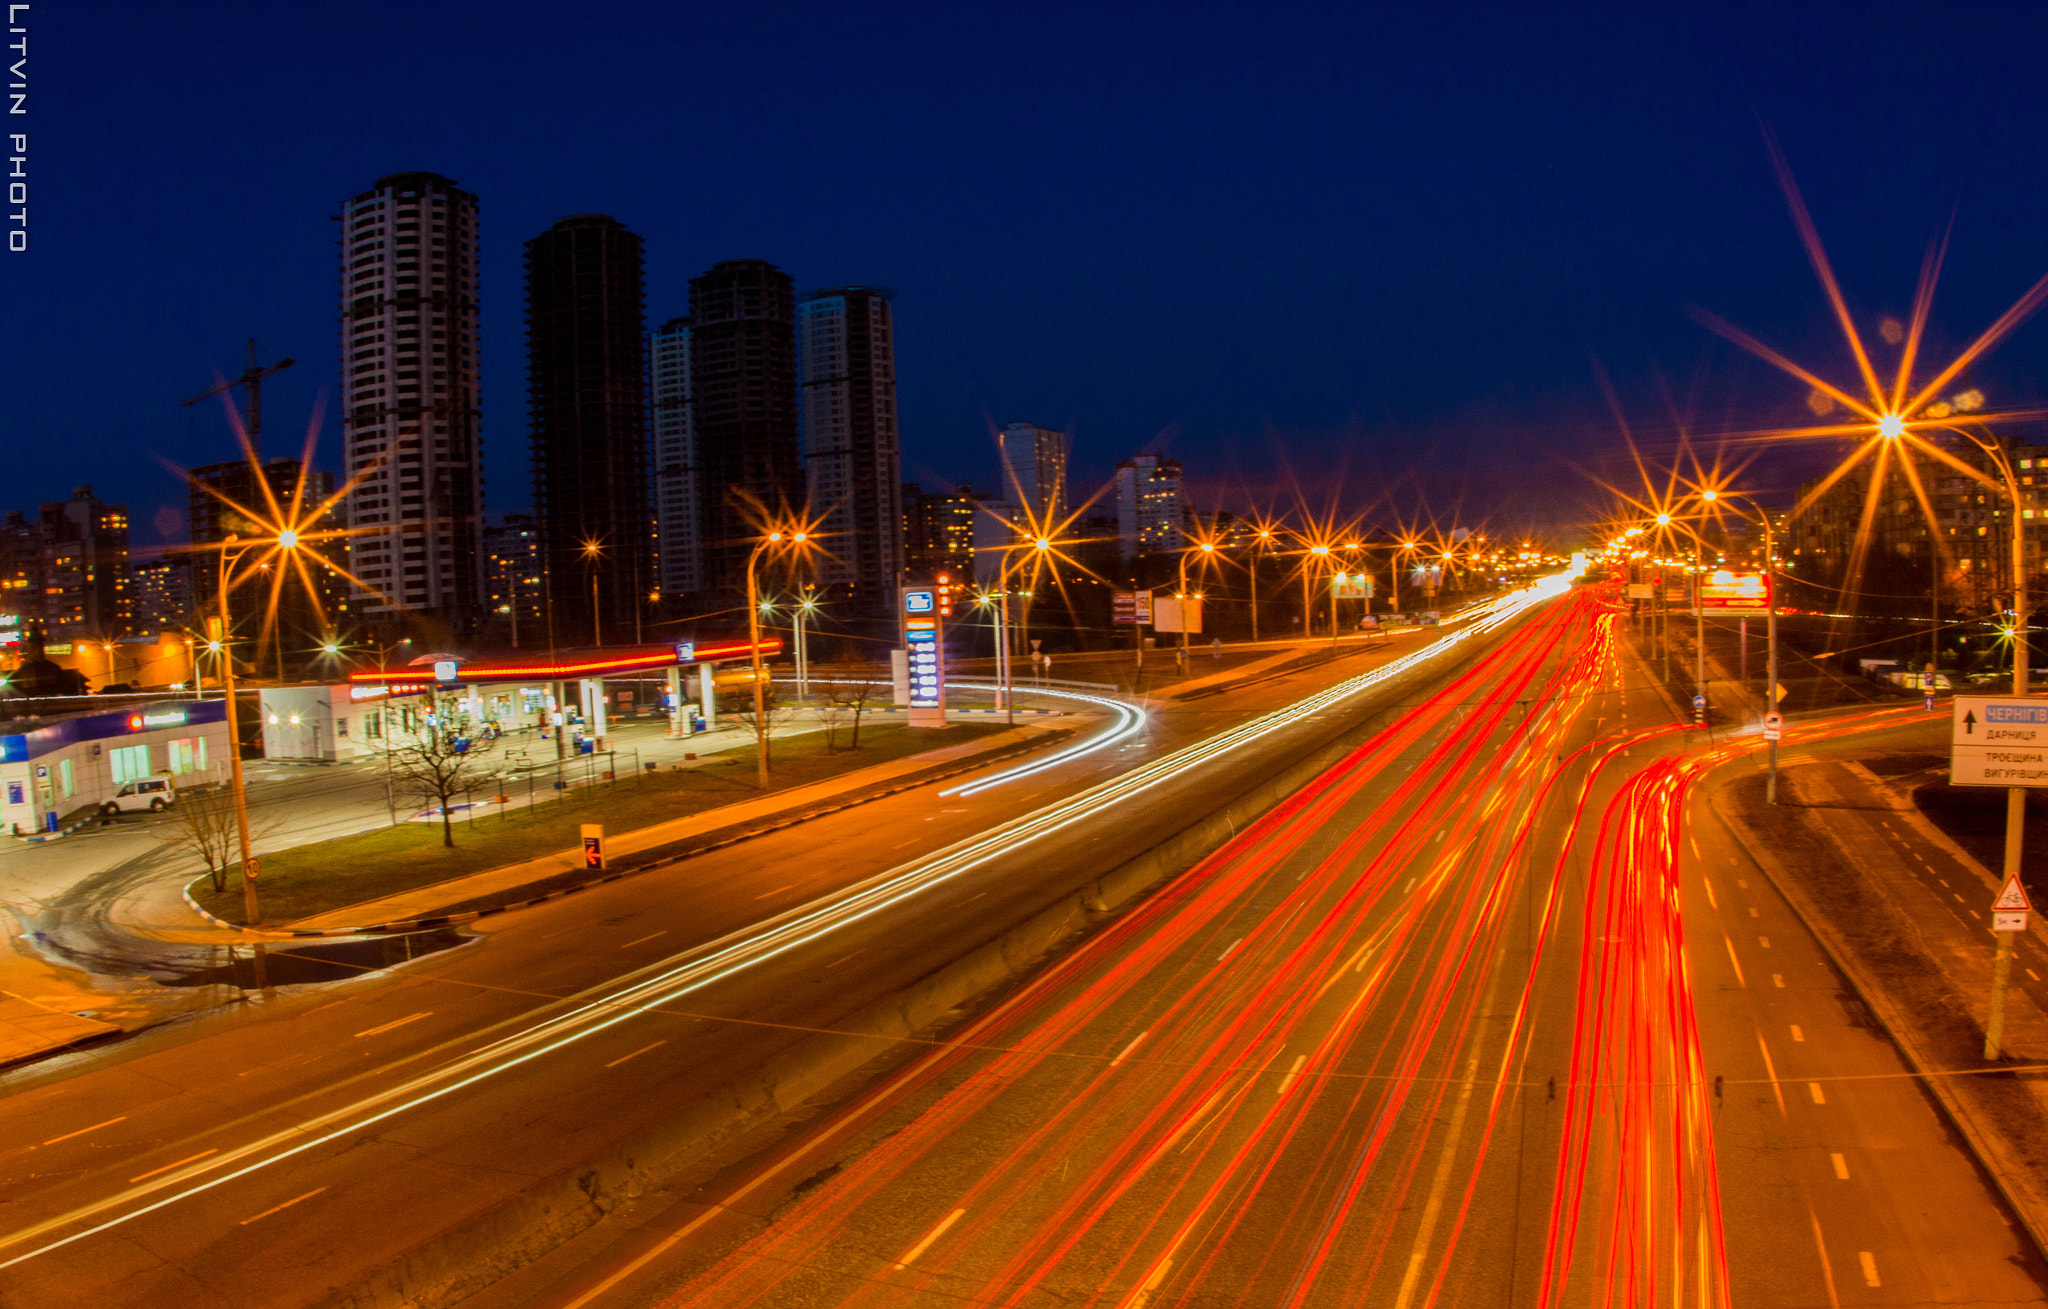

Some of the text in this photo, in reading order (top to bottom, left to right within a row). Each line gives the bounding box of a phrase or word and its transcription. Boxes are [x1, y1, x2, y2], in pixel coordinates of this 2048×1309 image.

[1987, 707, 2047, 722] ЧЕРНІГІВ
[1986, 729, 2036, 741] ДАРНИЦЯ
[1985, 752, 2043, 763] ТРОЄЩИНА
